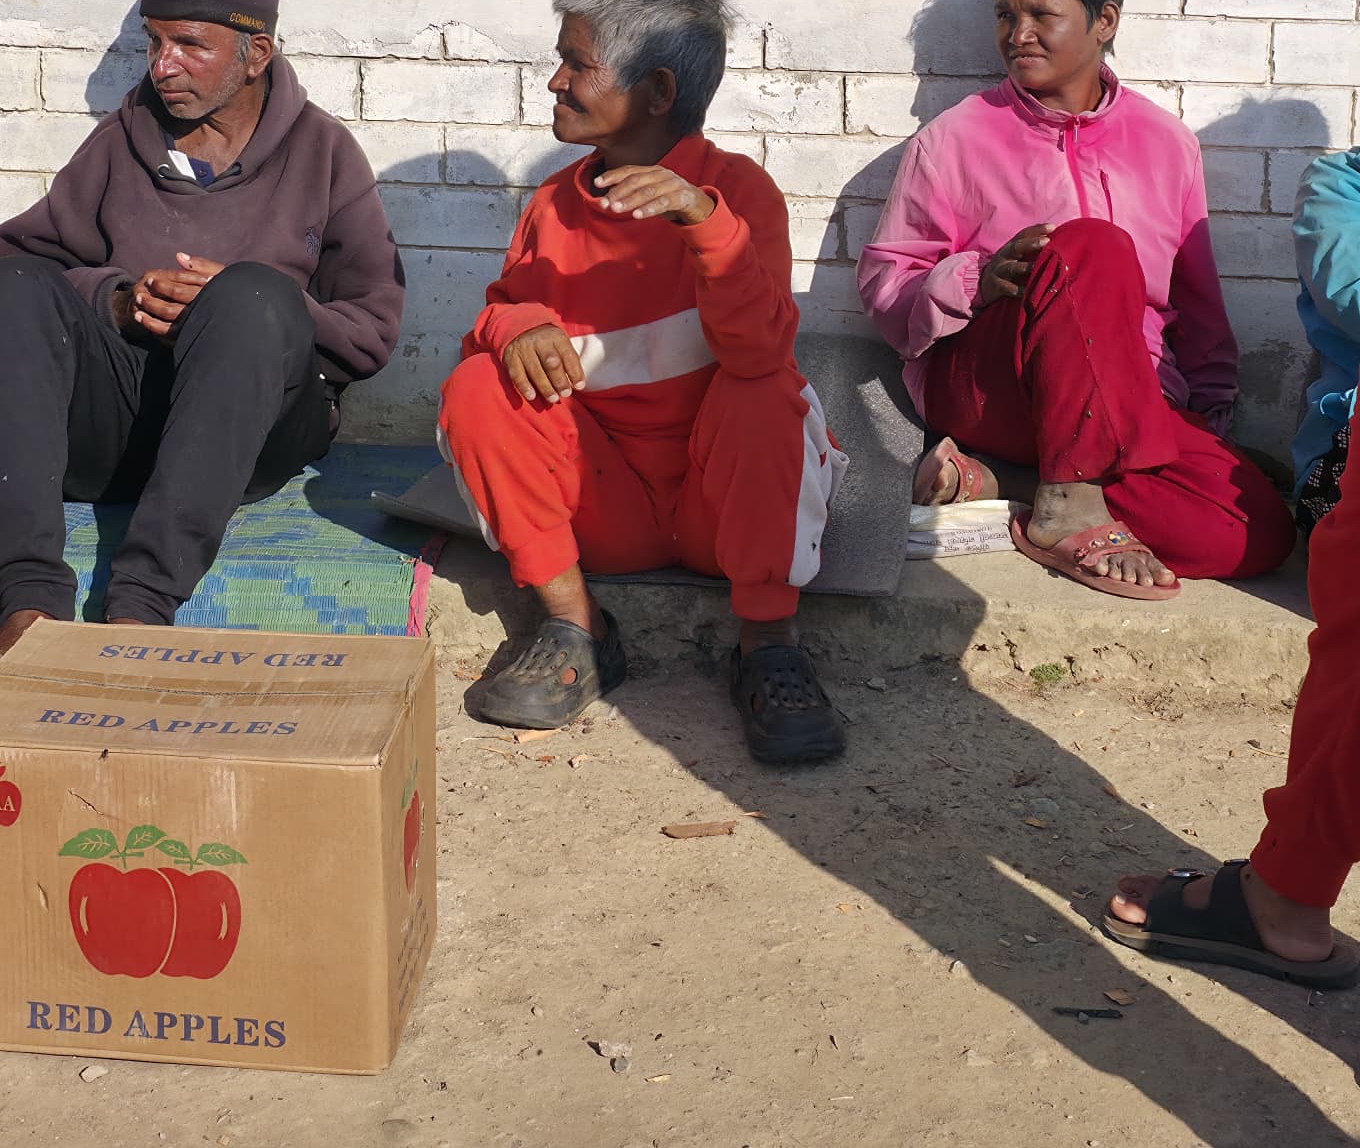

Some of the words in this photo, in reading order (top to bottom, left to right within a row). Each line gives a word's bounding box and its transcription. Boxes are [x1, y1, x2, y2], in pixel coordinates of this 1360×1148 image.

[99, 644, 256, 665] APPLES
[263, 653, 348, 667] RED
[37, 709, 126, 728] RED
[132, 718, 299, 735] APPLES
[27, 1001, 112, 1034] RED
[123, 1010, 287, 1048] APPLES
